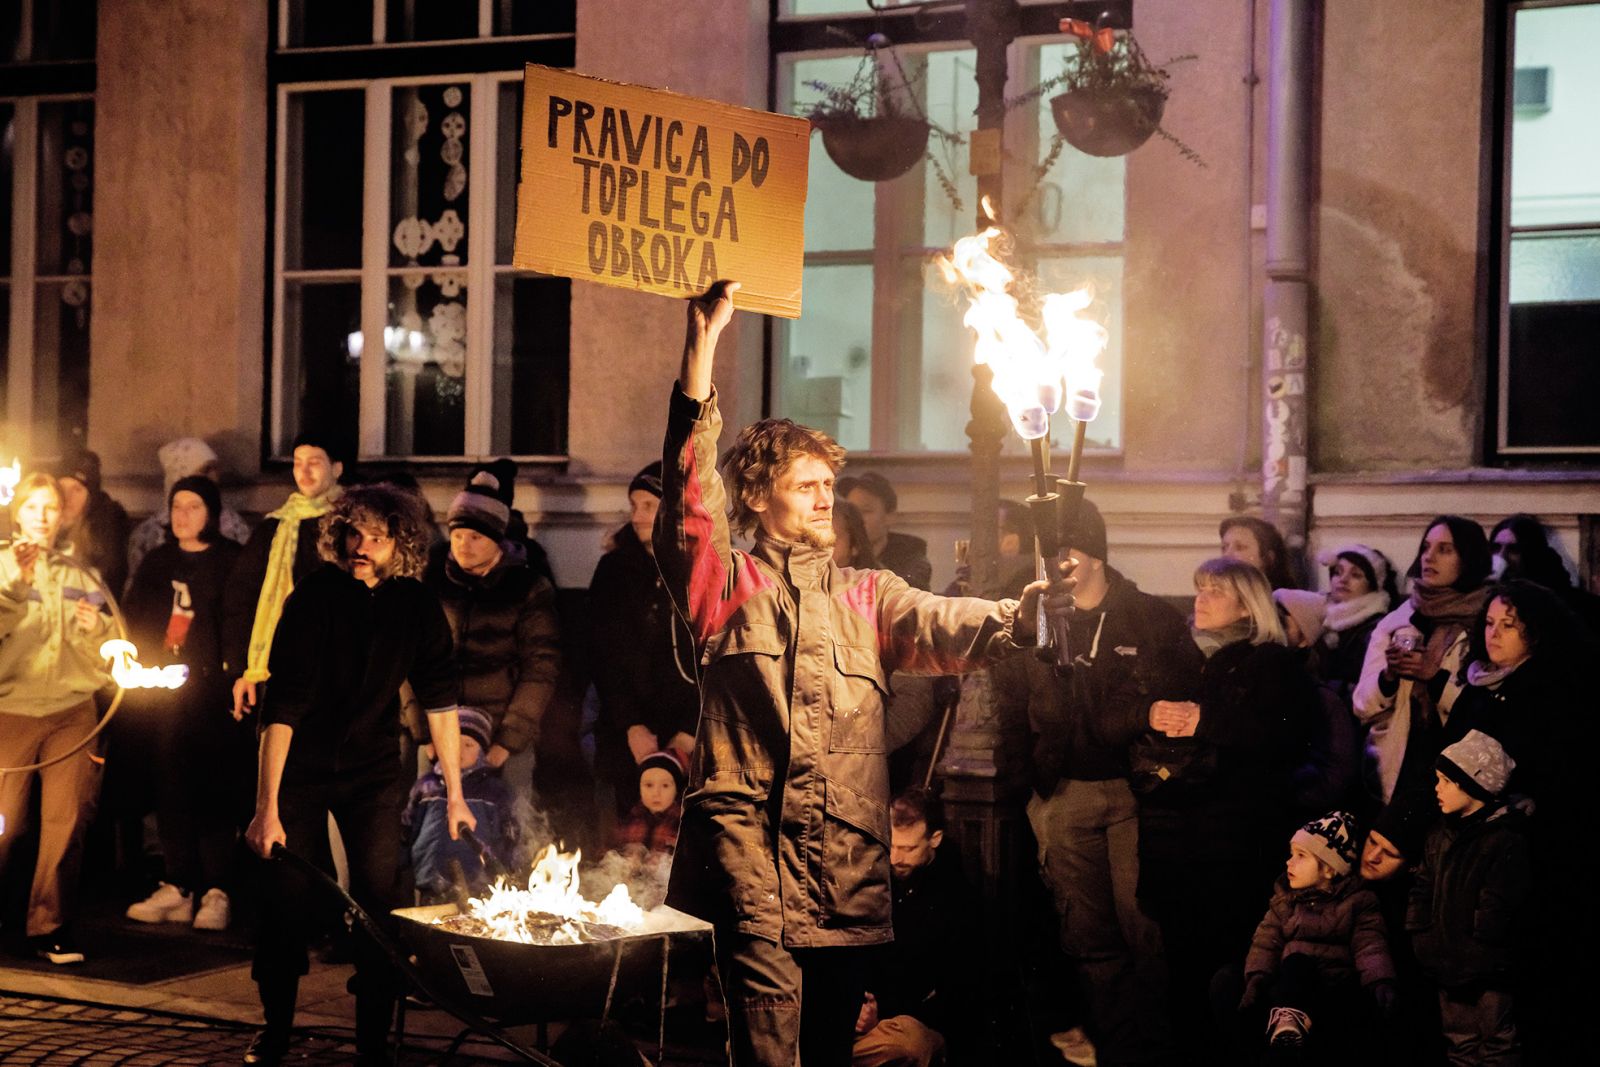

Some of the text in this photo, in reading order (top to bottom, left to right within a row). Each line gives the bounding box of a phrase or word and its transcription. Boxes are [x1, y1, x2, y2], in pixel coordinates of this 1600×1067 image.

[548, 96, 769, 188] PRAVICA DO
[573, 157, 739, 242] TOPLEGA
[588, 221, 718, 292] OBROKA
